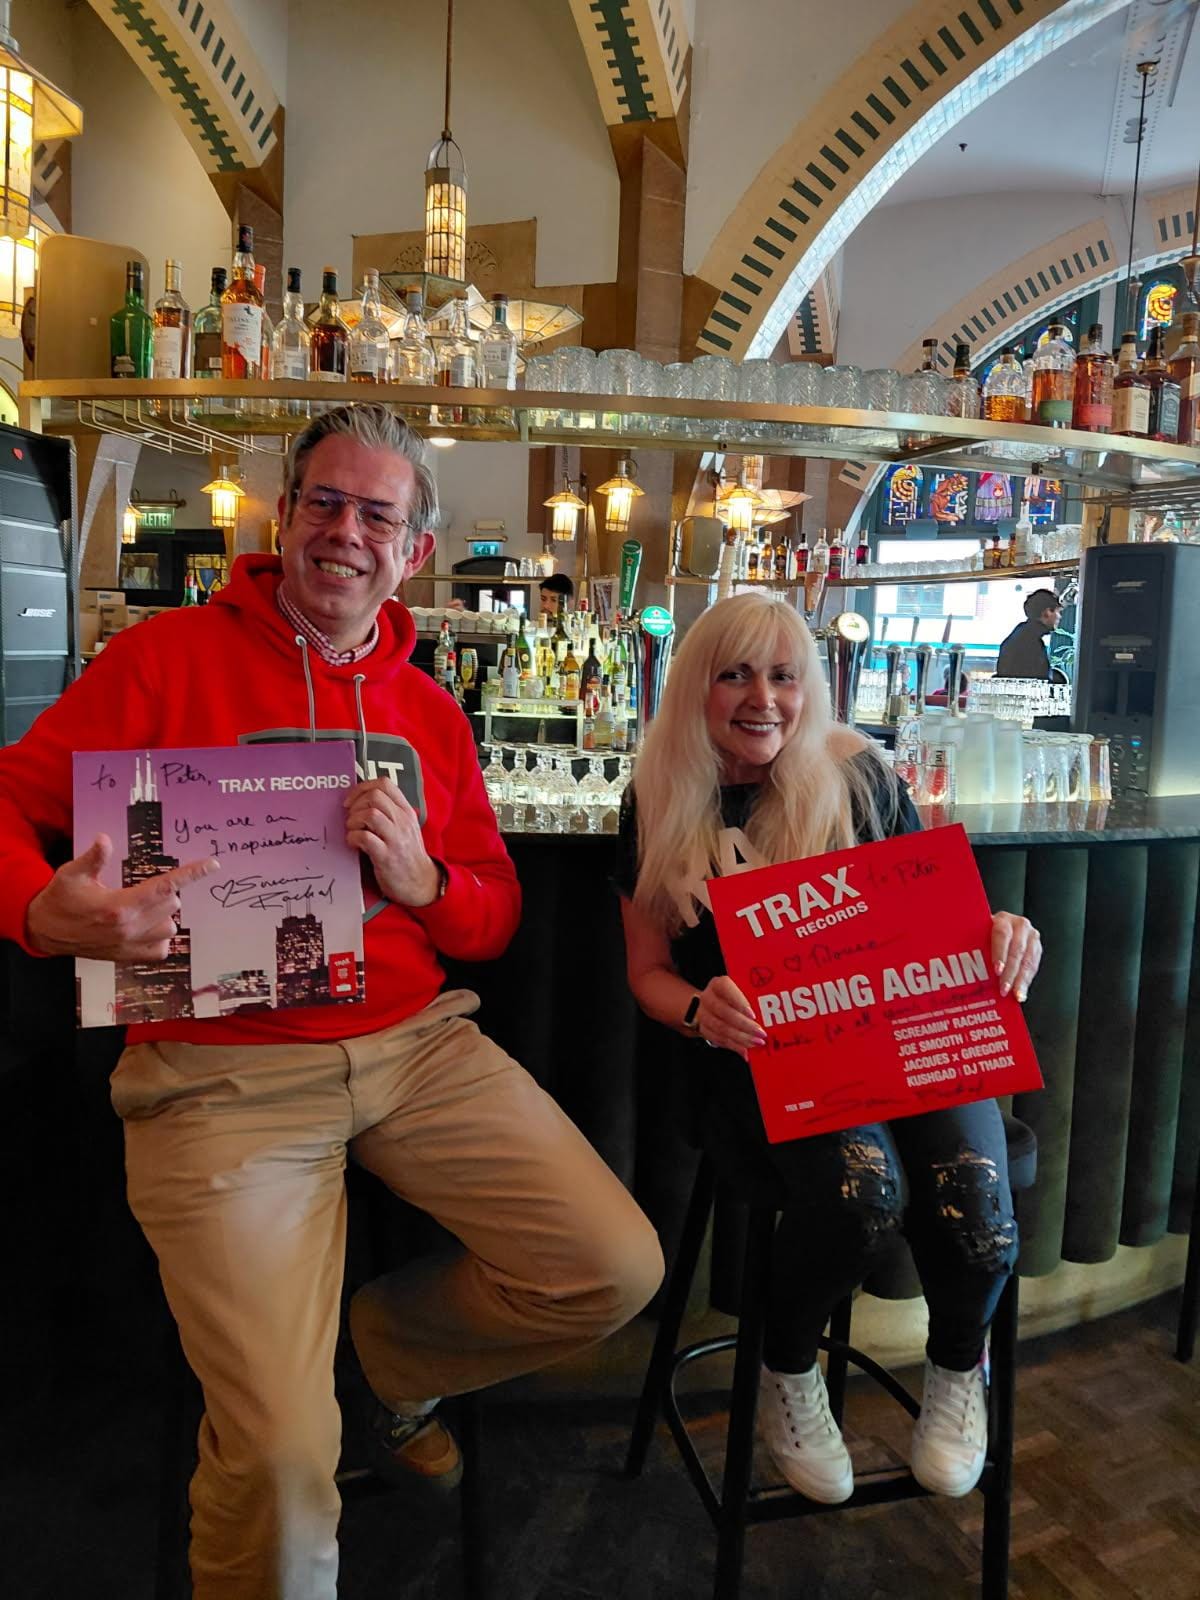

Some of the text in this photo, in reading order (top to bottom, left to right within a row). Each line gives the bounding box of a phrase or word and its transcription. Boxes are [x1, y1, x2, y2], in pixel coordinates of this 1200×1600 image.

[218, 774, 351, 793] TRAX RECORDS
[174, 818, 218, 843] You
[226, 816, 254, 828] are
[736, 866, 861, 938] TRAX
[795, 901, 869, 938] RECORDS
[757, 974, 875, 1027] RISING
[883, 949, 989, 1002] AGAIN
[952, 1010, 1002, 1029] RACHAEL
[898, 1025, 1006, 1057] JOE SMOOTH SPADA
[903, 1052, 950, 1072] JACQUES
[960, 1040, 1009, 1060] GREGORY
[962, 1062, 978, 1076] DJ
